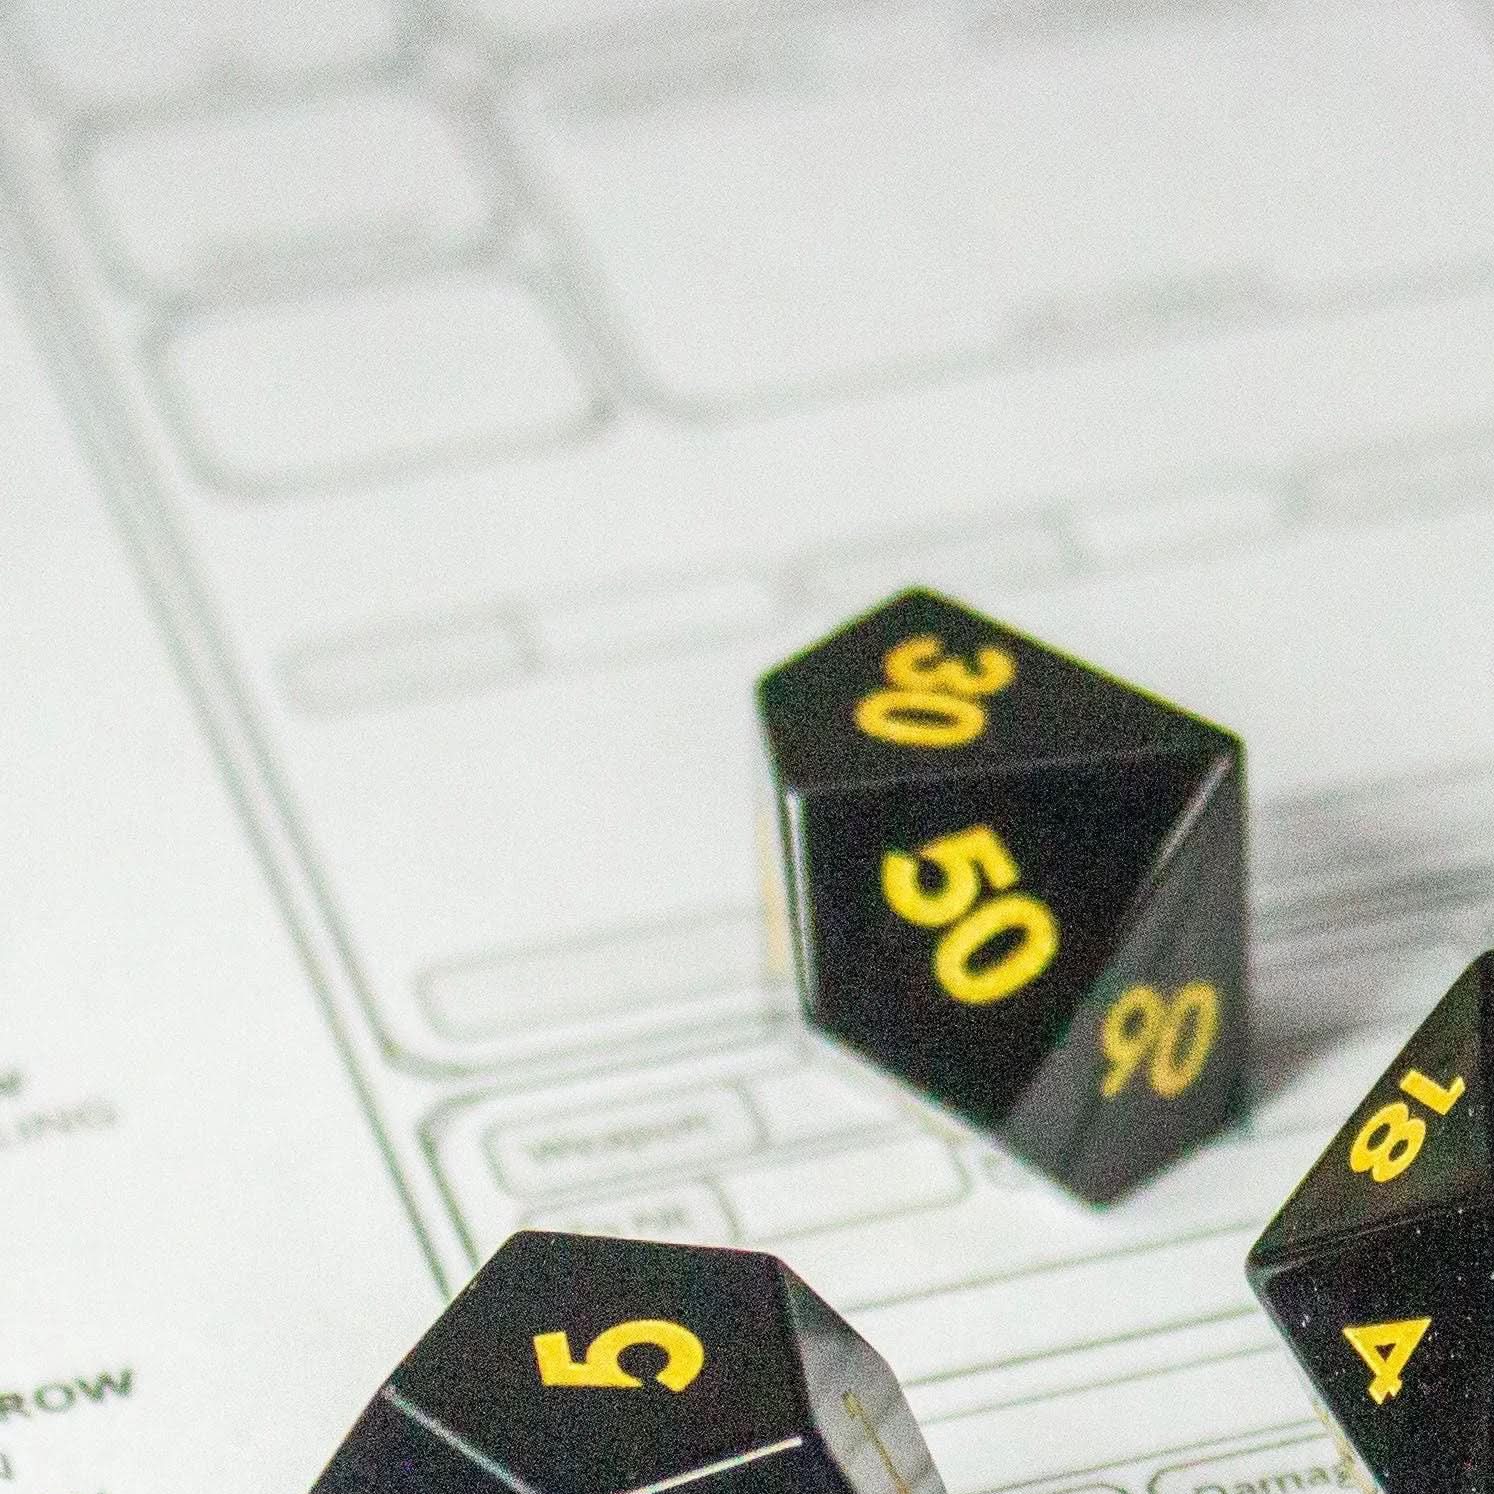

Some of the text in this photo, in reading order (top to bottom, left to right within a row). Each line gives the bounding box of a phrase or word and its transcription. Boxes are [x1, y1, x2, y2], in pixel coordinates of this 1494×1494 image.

[853, 634, 1018, 750] 30
[880, 824, 1060, 1005] 50
[1100, 981, 1220, 1099] 90
[1347, 1068, 1467, 1185] 18
[532, 1317, 706, 1394] 5
[1343, 1316, 1432, 1405] 4
